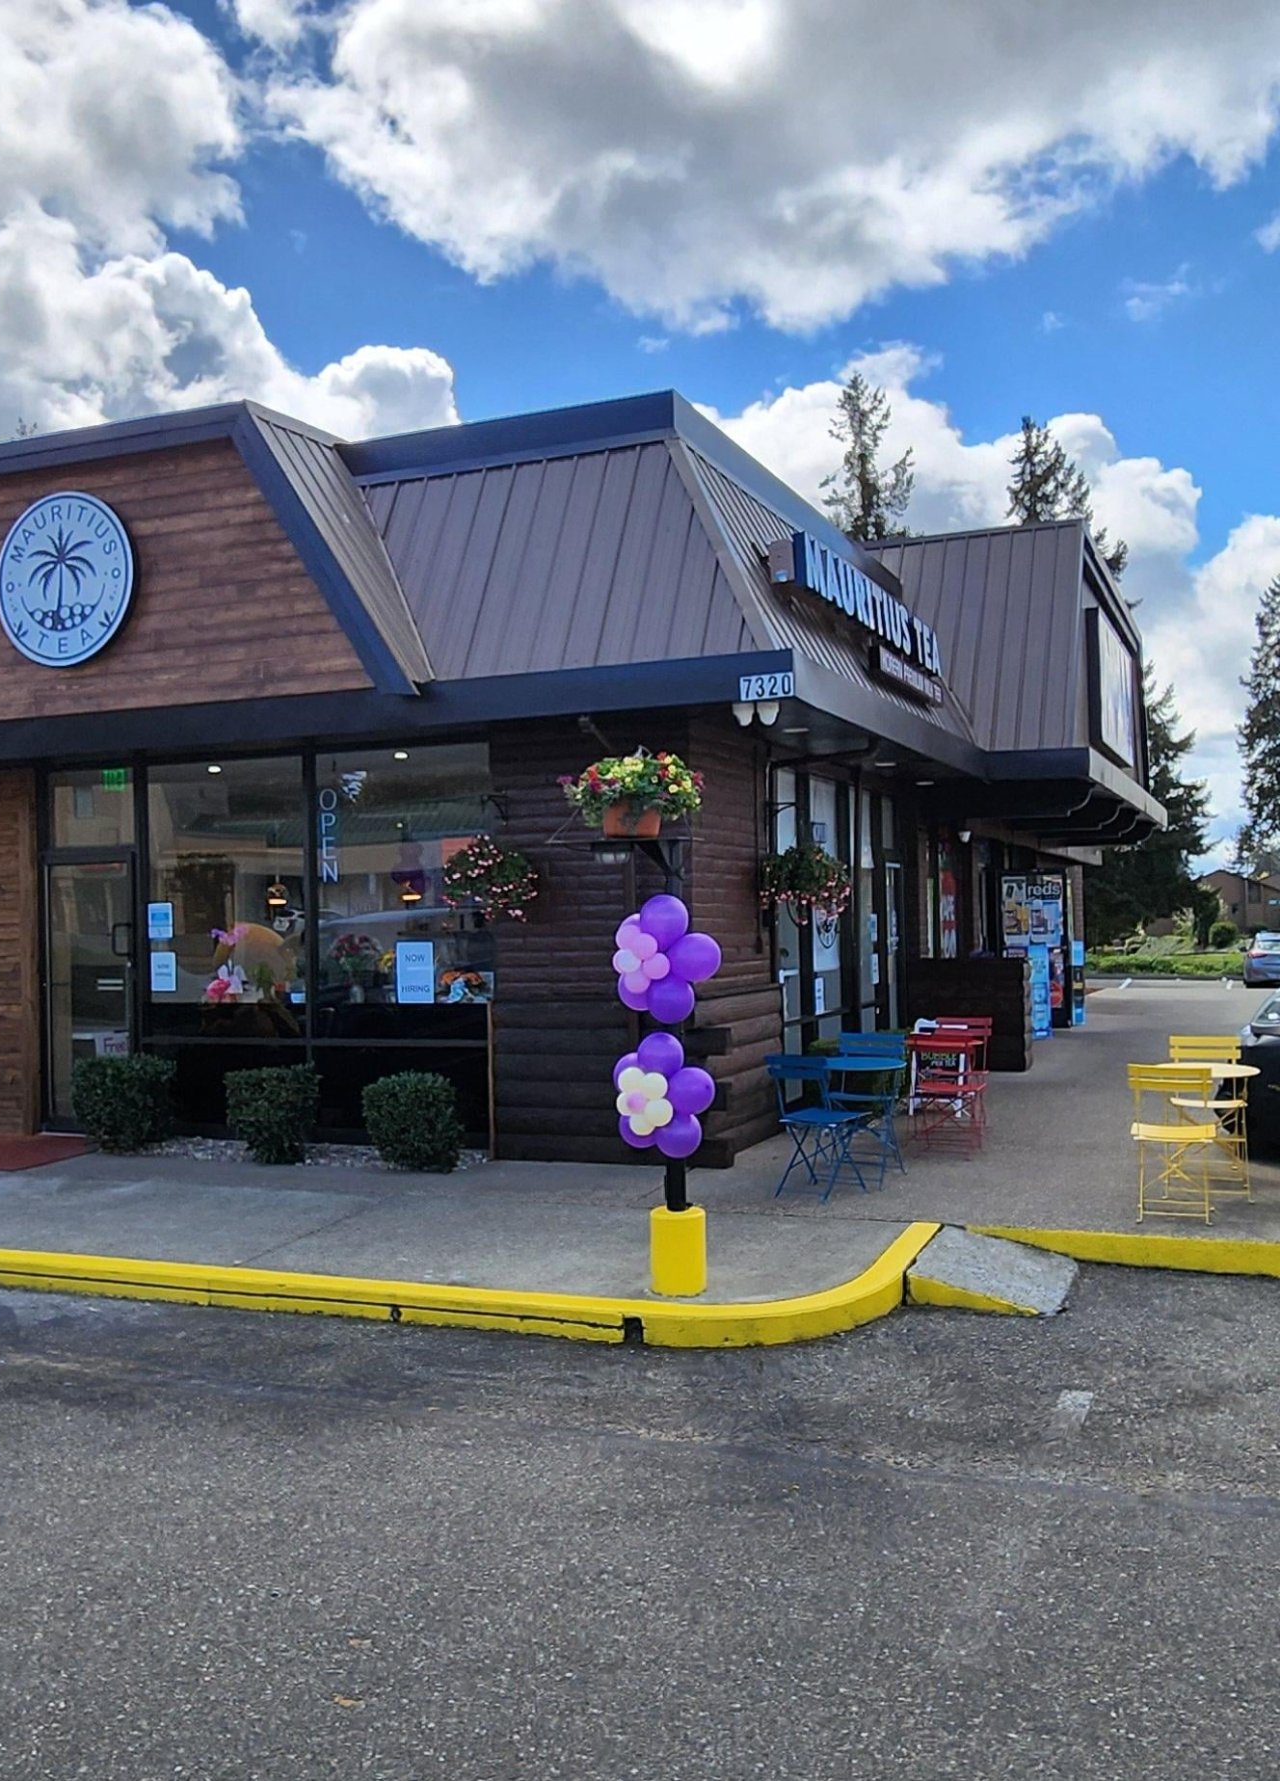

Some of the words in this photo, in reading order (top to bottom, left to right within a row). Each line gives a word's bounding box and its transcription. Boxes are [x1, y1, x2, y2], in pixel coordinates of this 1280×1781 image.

[10, 503, 117, 564] MAURITIUS
[804, 533, 911, 655] MAURITIUS
[913, 614, 942, 678] TEA
[37, 629, 94, 654] TEA
[744, 674, 791, 698] 7320
[319, 787, 339, 883] OPEN
[404, 953, 425, 962] NOW
[401, 984, 431, 993] HIRING
